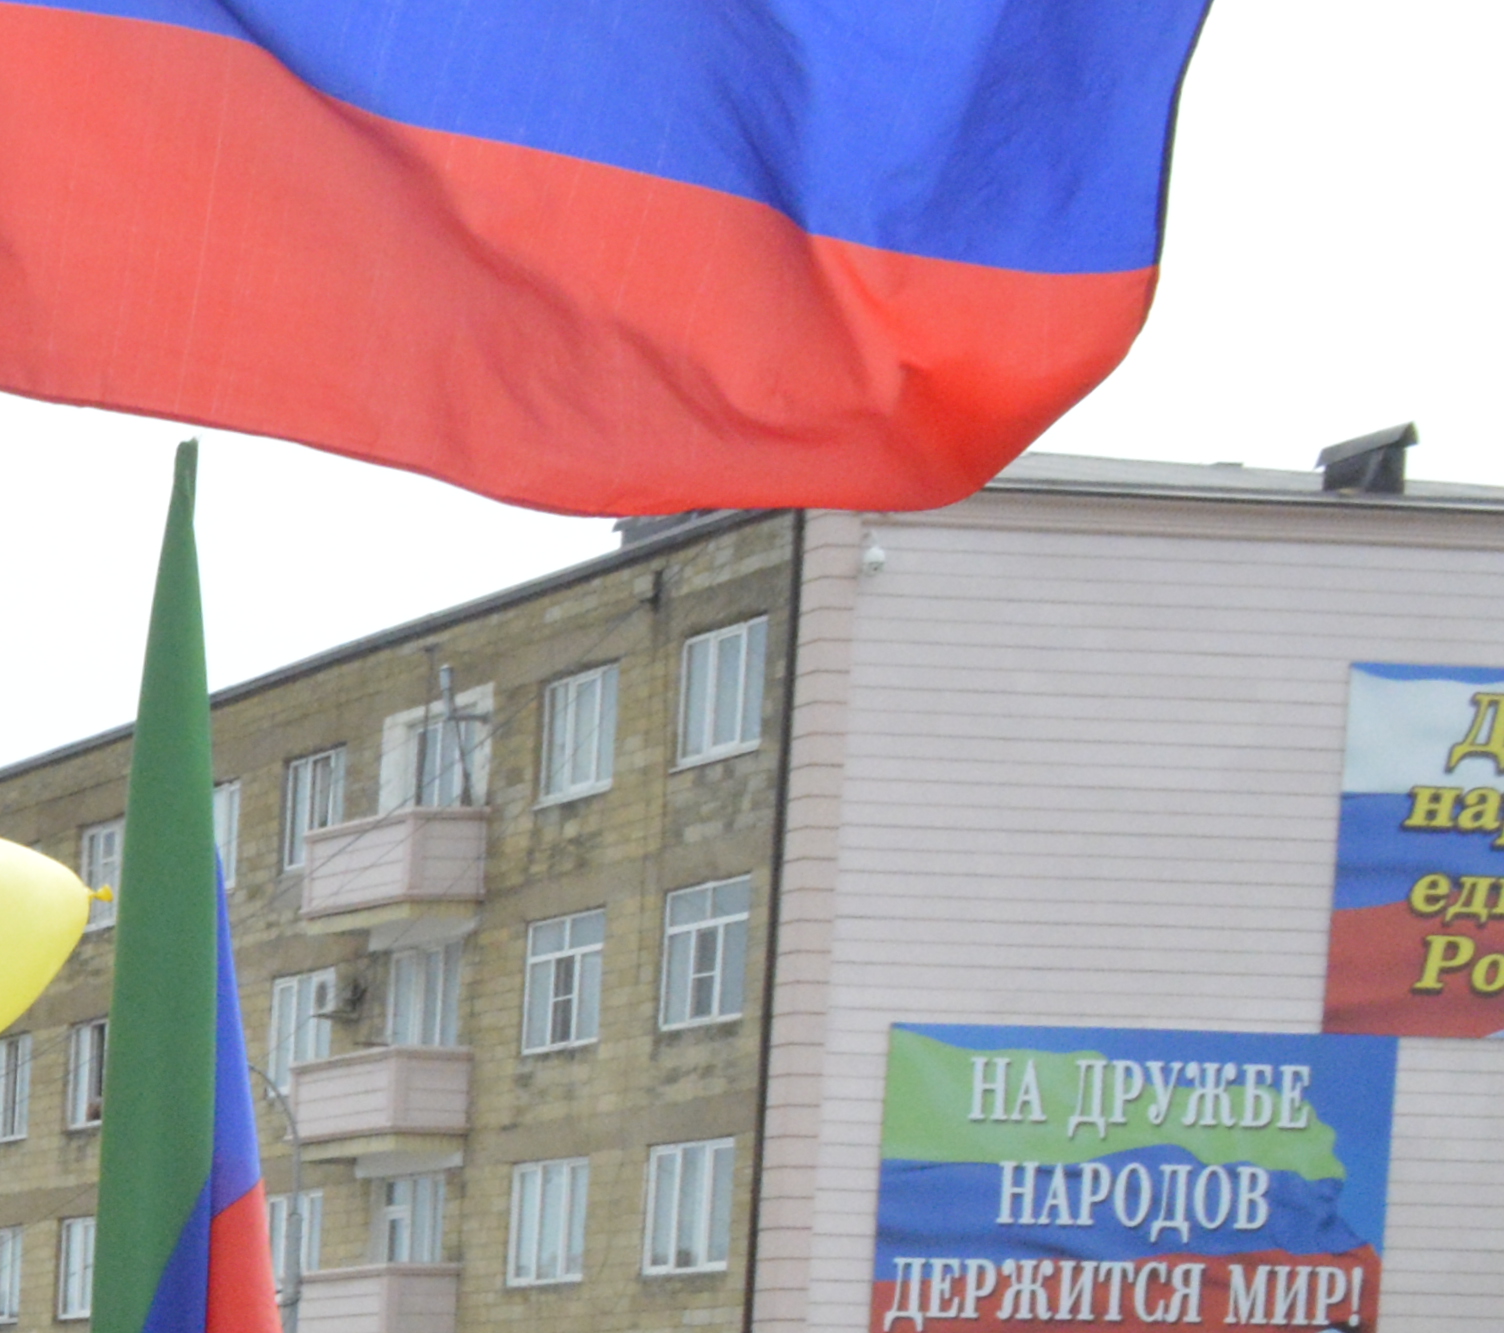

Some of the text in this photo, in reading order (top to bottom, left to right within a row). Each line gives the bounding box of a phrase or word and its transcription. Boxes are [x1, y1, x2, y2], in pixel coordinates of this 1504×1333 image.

[1402, 786, 1504, 852] на
[968, 1056, 1311, 1138] НА ДРУЖБЕ
[995, 1161, 1270, 1243] НАРОДОВ
[883, 1257, 1364, 1332] ДЕРЖИТСЯ МИР!
